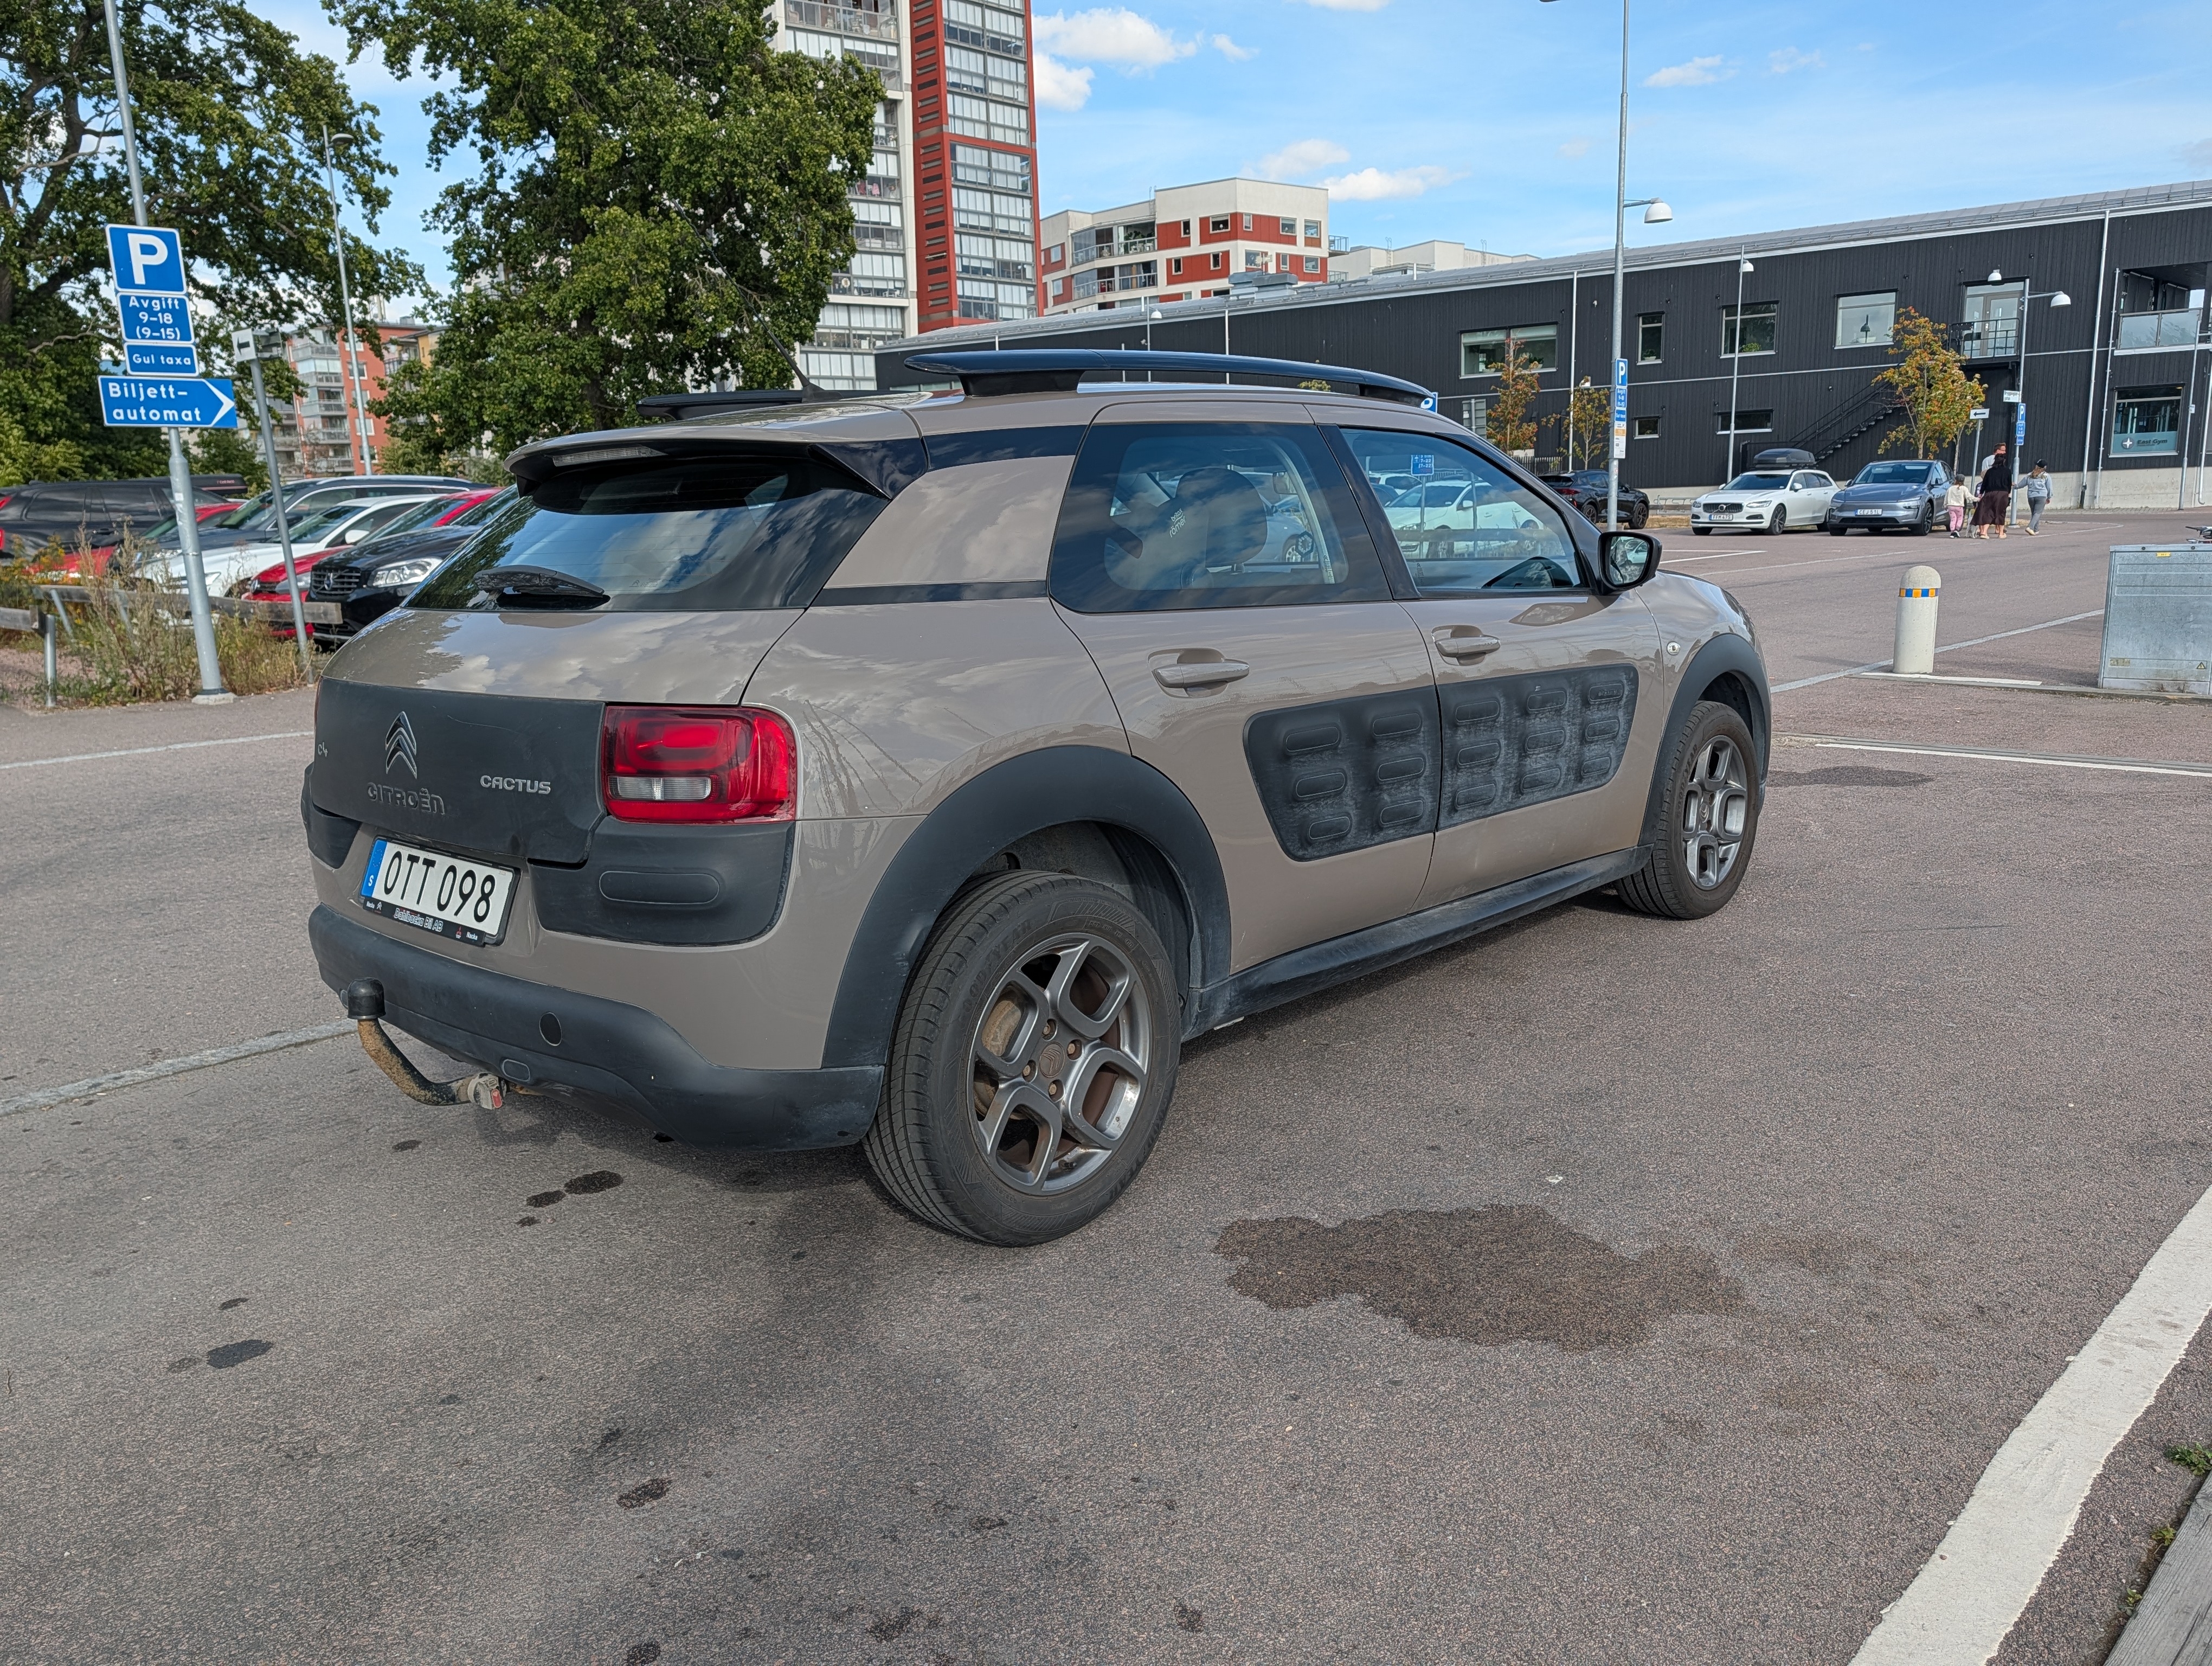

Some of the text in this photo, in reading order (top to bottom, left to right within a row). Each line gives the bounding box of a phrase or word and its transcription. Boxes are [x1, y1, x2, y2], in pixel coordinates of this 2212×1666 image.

[127, 233, 168, 285] P
[129, 296, 180, 311] Avgift
[138, 312, 173, 324] 9-18
[136, 326, 181, 341] (9-15)
[132, 354, 191, 366] Gul taxa
[1619, 362, 1625, 384] P
[108, 382, 188, 402] Biljett-
[112, 406, 202, 422] automat
[2020, 405, 2024, 420] P
[1169, 516, 1186, 537] römer
[318, 741, 328, 758] C4
[480, 775, 551, 794] CACTUS
[368, 875, 374, 887] S
[384, 850, 496, 923] OTT 098
[423, 917, 434, 929] Bil
[432, 919, 443, 932] AB
[466, 931, 478, 940] Nacka
